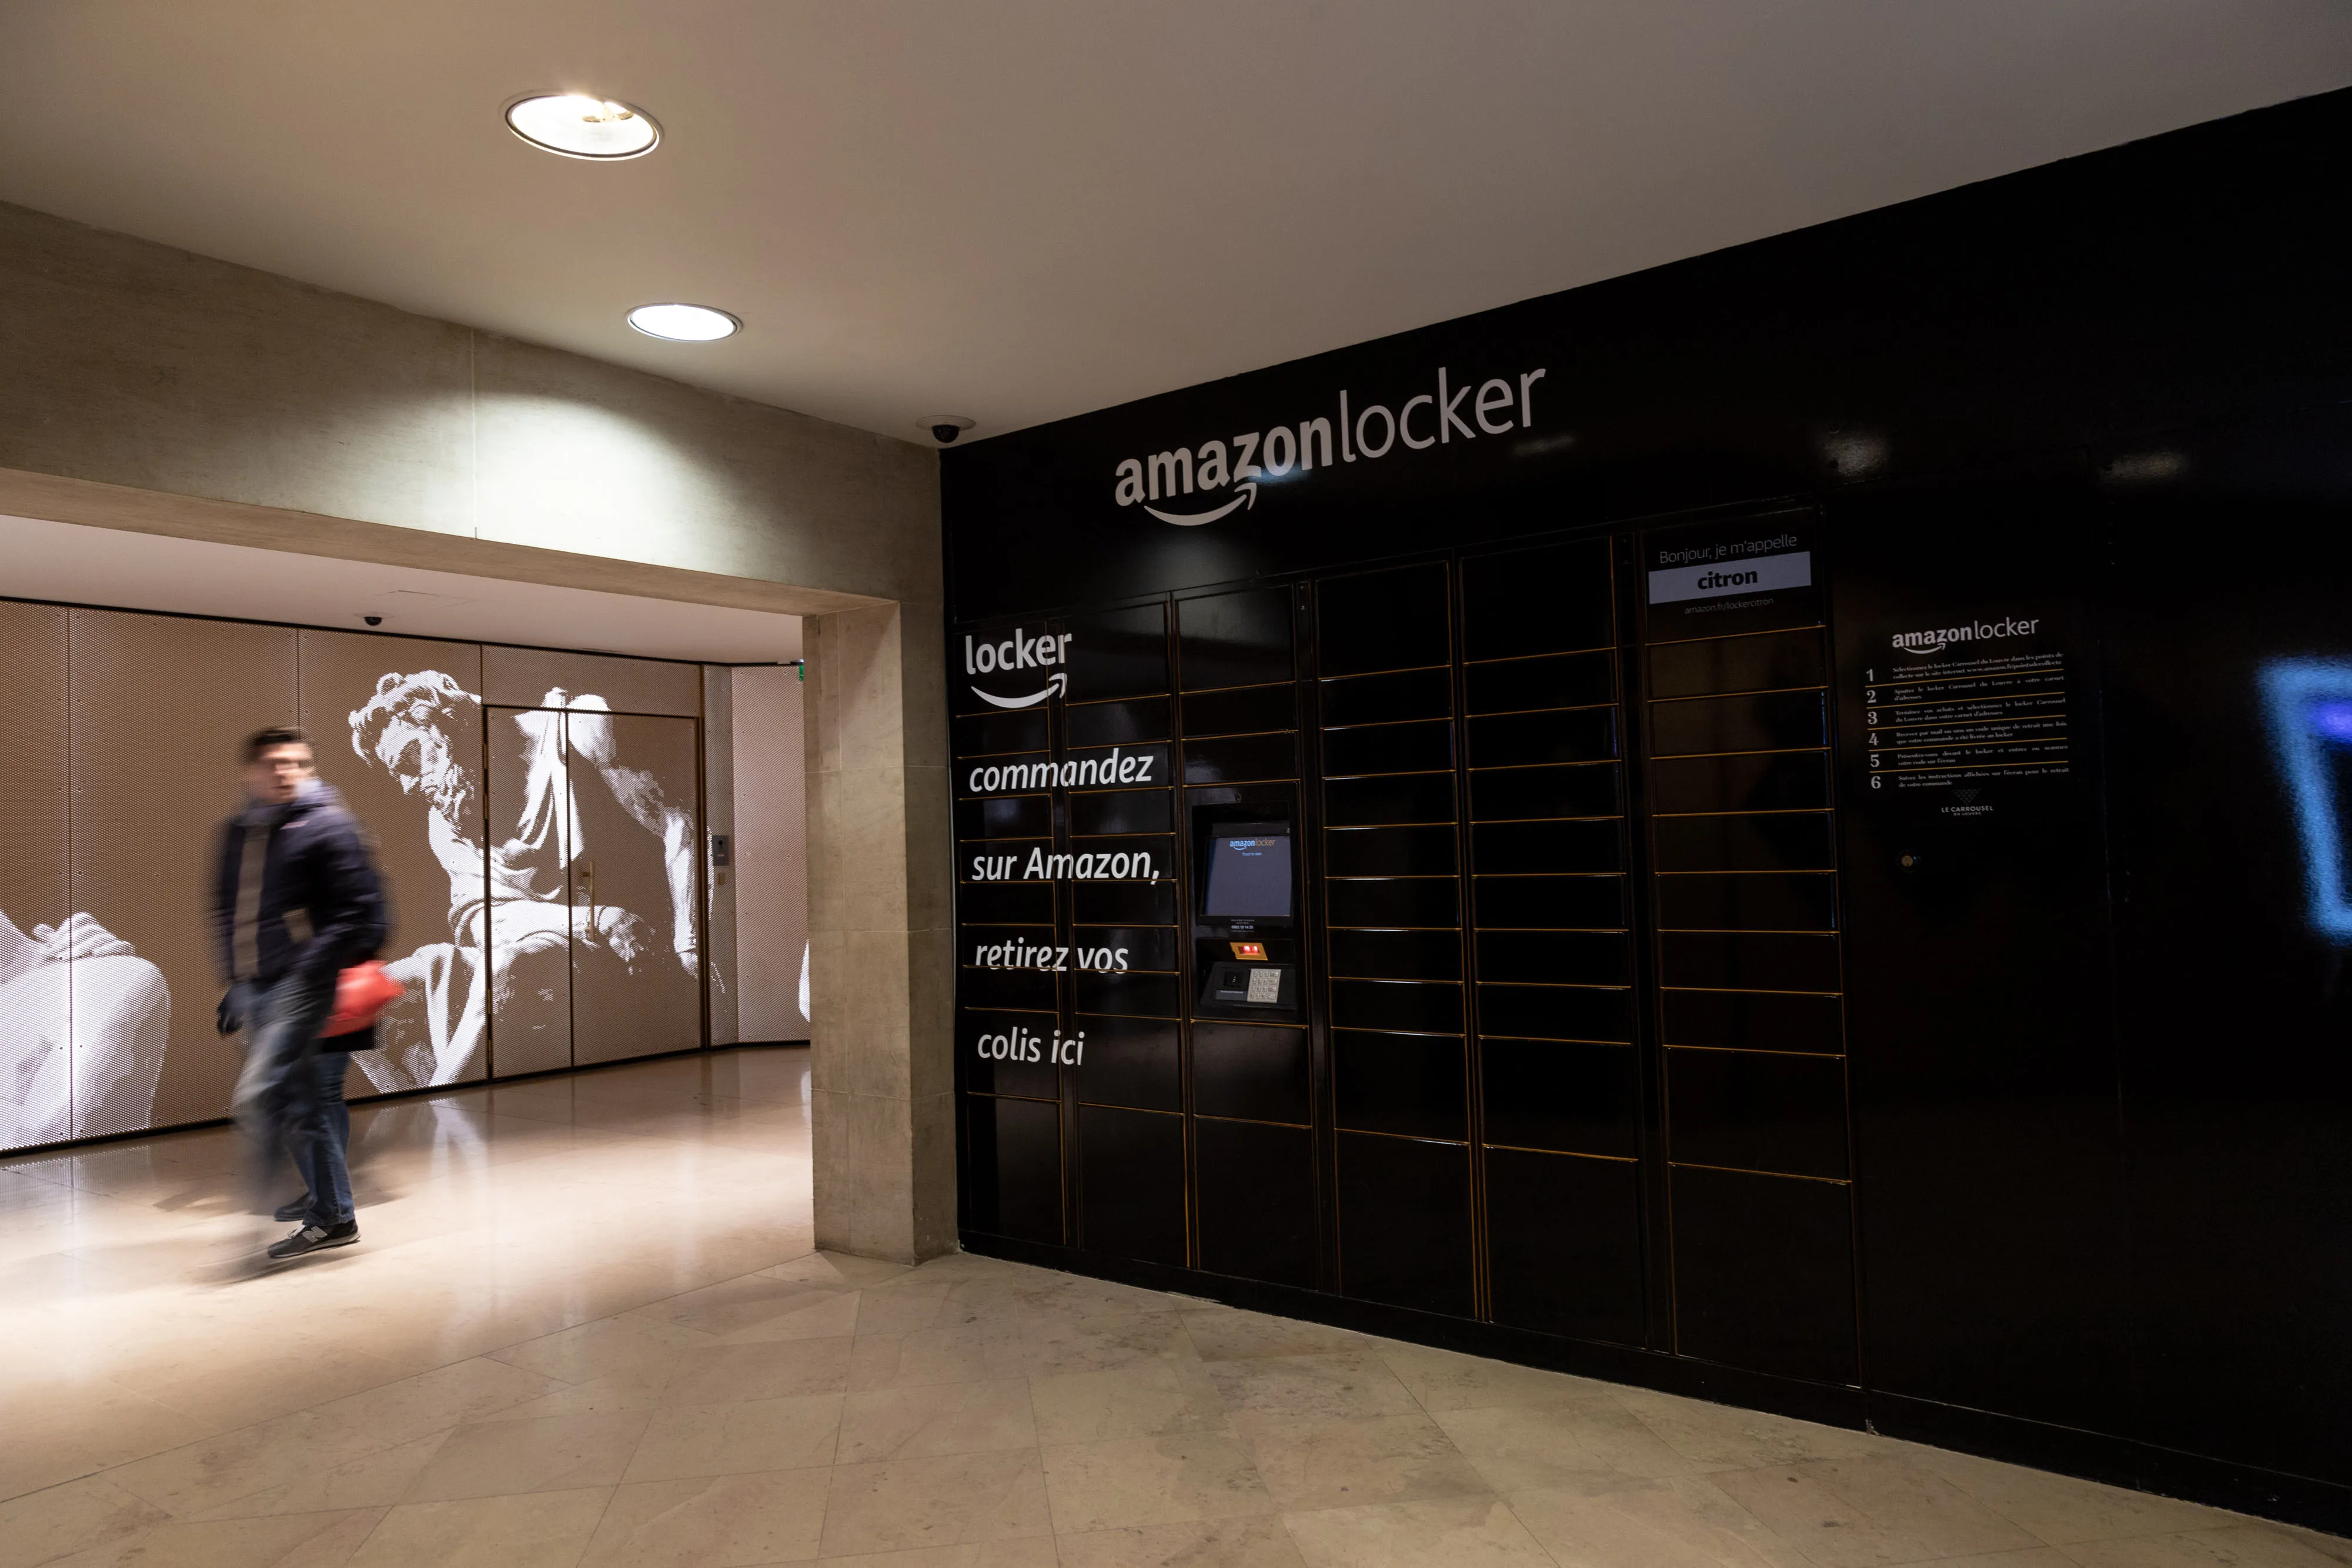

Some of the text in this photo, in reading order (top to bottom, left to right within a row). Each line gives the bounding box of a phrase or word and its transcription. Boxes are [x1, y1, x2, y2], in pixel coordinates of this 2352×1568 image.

[1115, 366, 1546, 507] amazonlocker
[1659, 533, 1798, 564] Bonjour, je m'appelle
[1697, 570, 1758, 590] citron
[1684, 597, 1775, 615] amazon.fr/lockercitron
[1892, 616, 2040, 648] amazonlocker
[965, 627, 1073, 676] locker
[1866, 668, 1874, 682] 1
[1867, 690, 1877, 704] 2
[1867, 711, 1878, 725] 3
[1869, 732, 1880, 746] 4
[969, 747, 1154, 793] commandez
[1870, 753, 1880, 767] 5
[1871, 775, 1882, 789] 6
[971, 847, 1161, 886] sur Amazon,
[975, 936, 1130, 975] retirez vos
[977, 1026, 1085, 1066] colis ici
